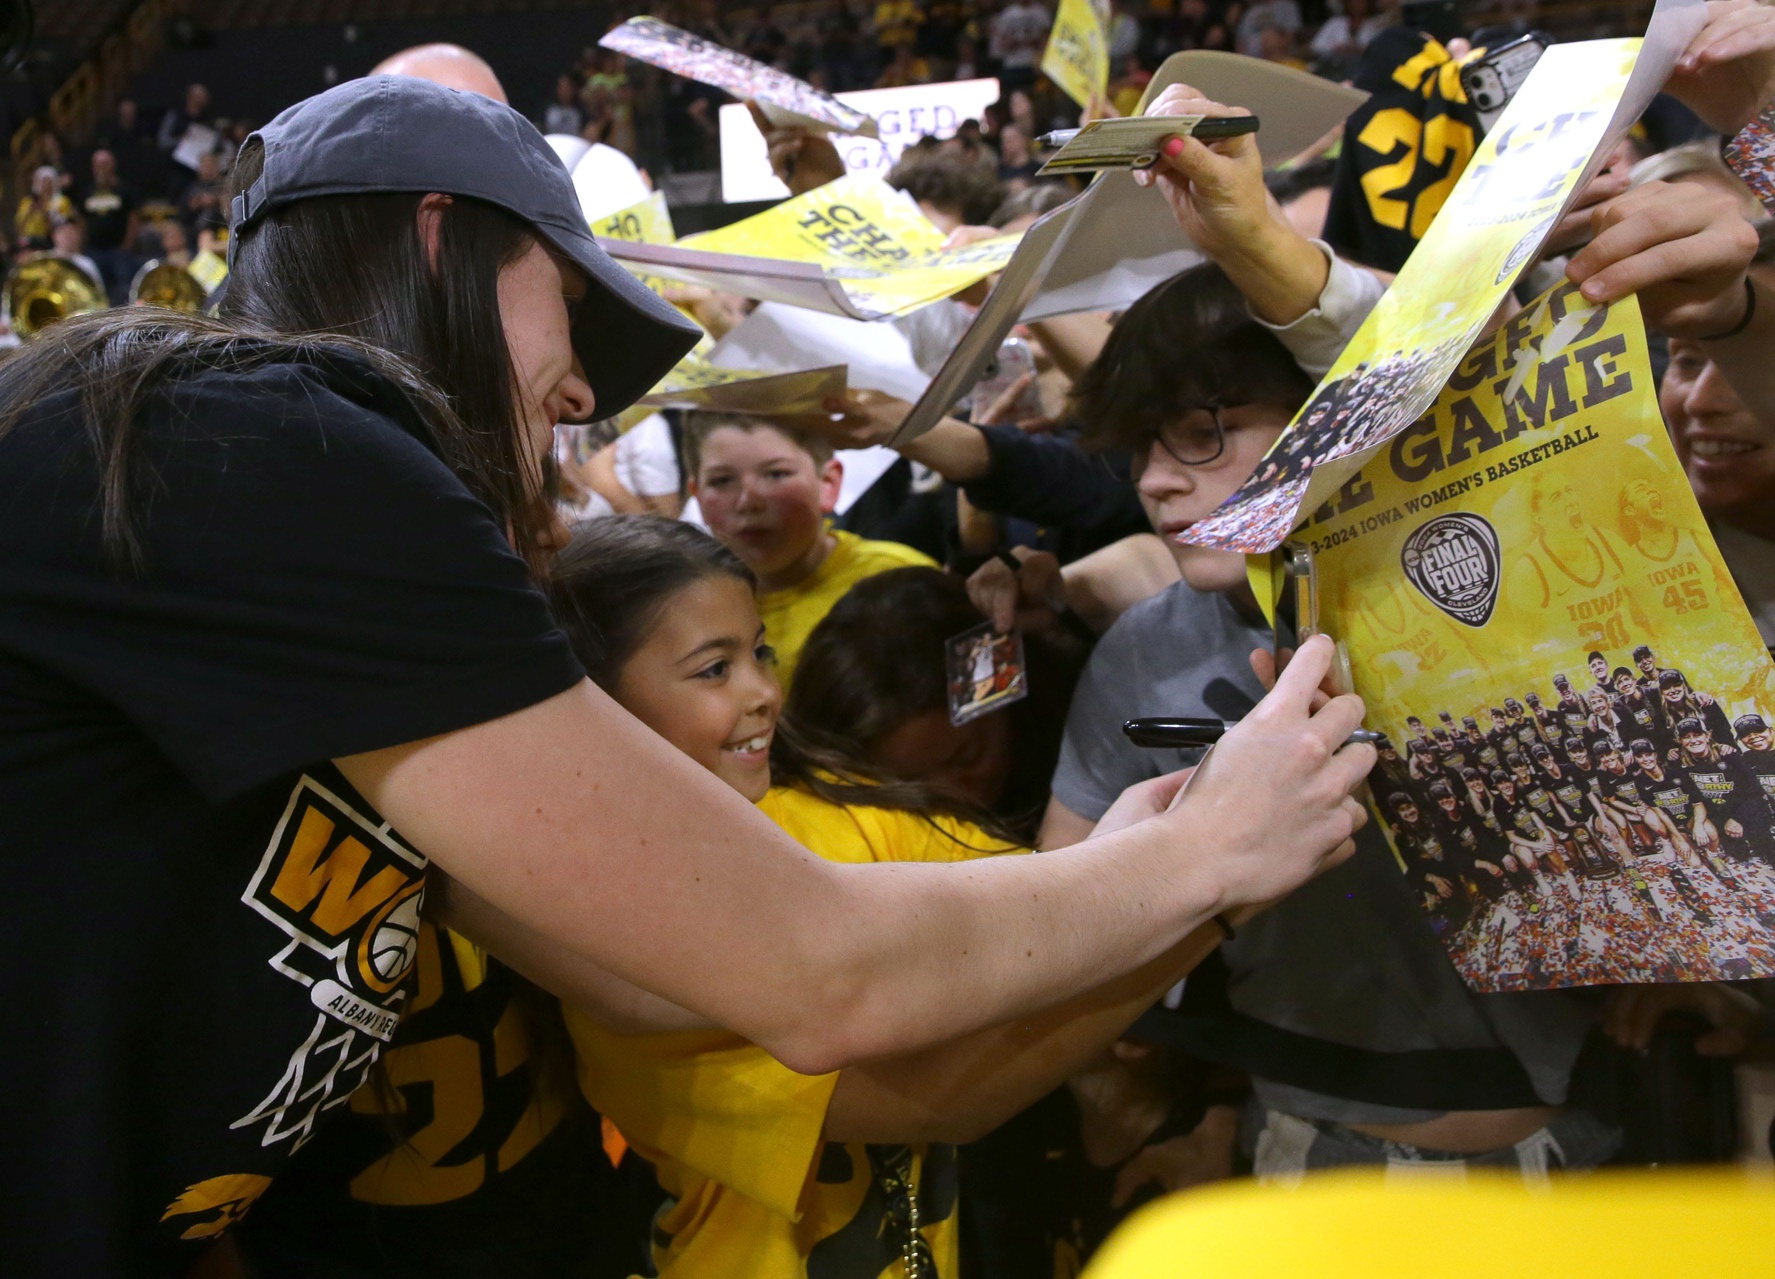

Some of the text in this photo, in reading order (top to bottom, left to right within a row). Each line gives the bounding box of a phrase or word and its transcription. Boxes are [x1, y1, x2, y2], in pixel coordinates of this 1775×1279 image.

[1389, 333, 1634, 483] GAME
[1361, 507, 1405, 536] IOWA
[1403, 470, 1485, 516] WOMEN'S
[1487, 424, 1600, 484] BASKETBALL
[1421, 534, 1479, 572] FINAL
[1430, 557, 1489, 597] FOUR
[1663, 578, 1710, 615] 45
[1447, 587, 1489, 607] CLEVELAND
[1577, 610, 1631, 652] 20
[327, 995, 382, 1030] ALBANY
